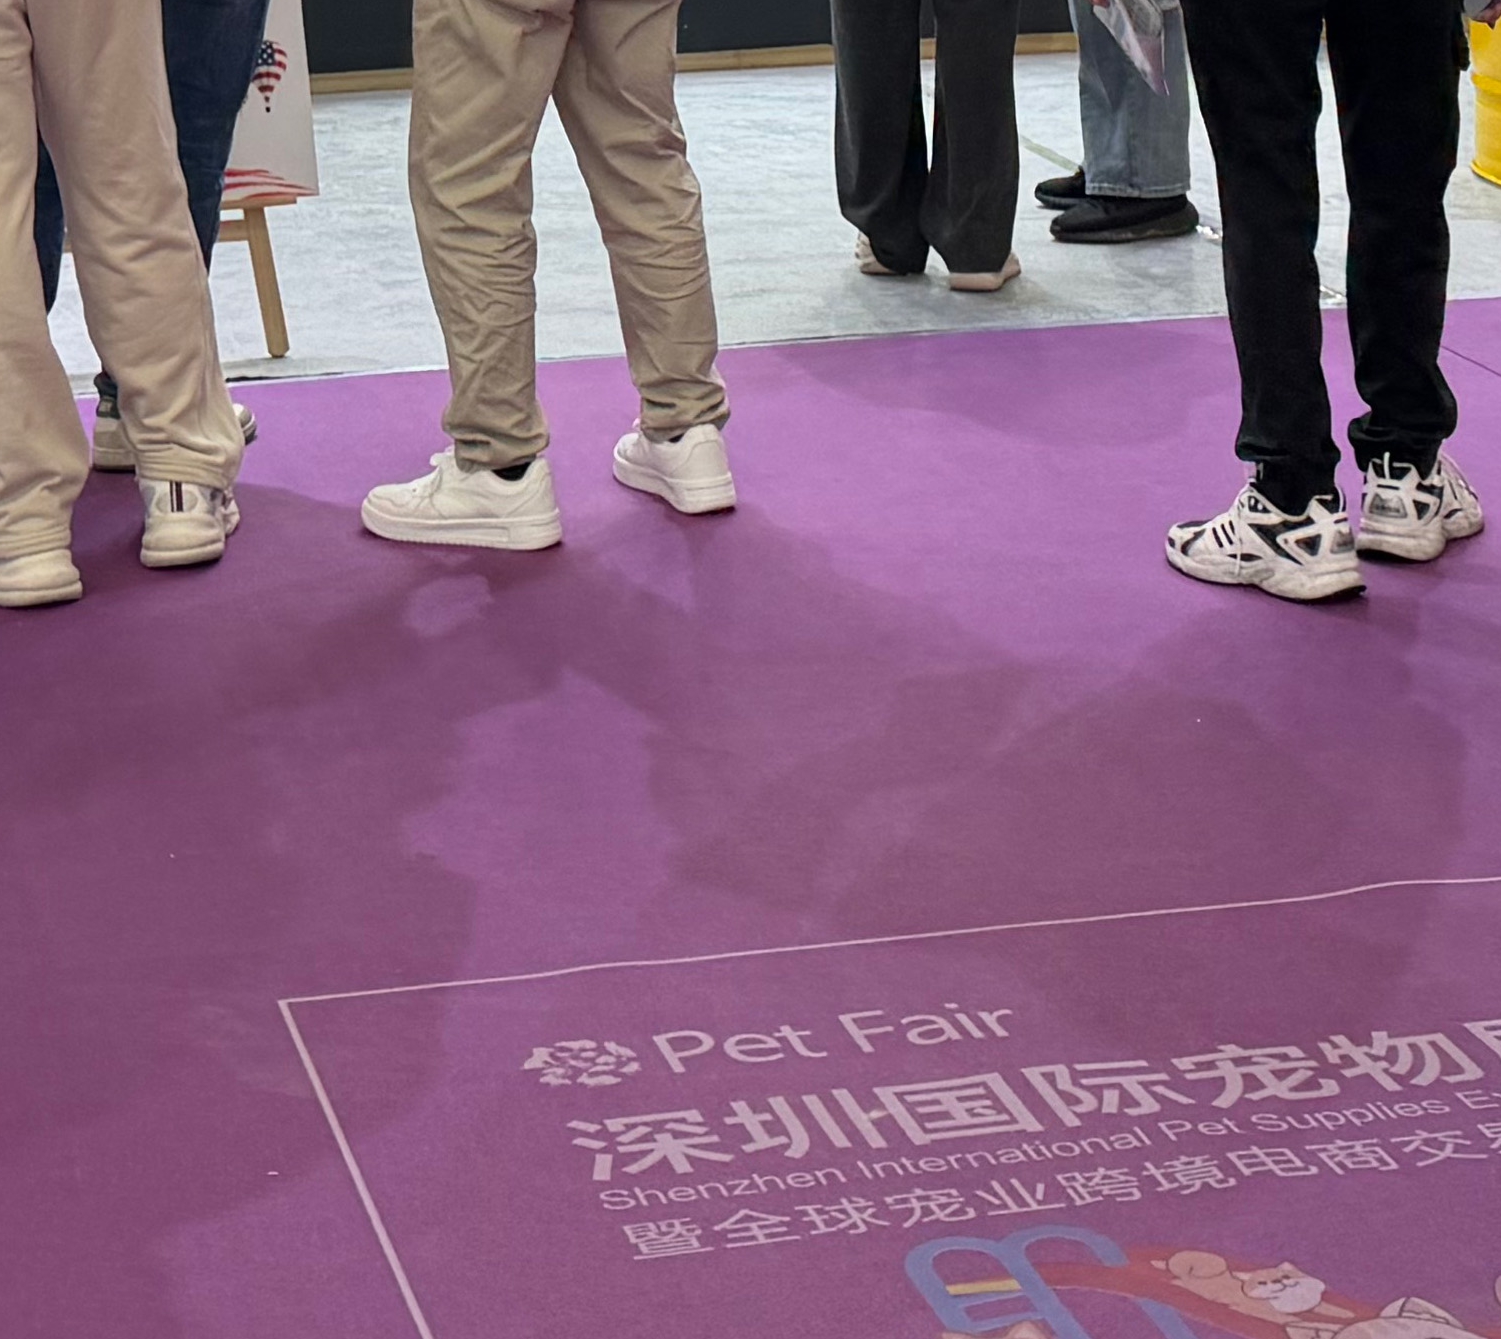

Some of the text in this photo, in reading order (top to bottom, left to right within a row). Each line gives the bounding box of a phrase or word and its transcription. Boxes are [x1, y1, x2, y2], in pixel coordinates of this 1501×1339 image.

[651, 1002, 1014, 1074] Pet Fair
[599, 1162, 848, 1211] Shenzhen
[855, 1127, 1150, 1182] International
[1158, 1113, 1240, 1142] Pet
[1249, 1092, 1451, 1138] Supplies
